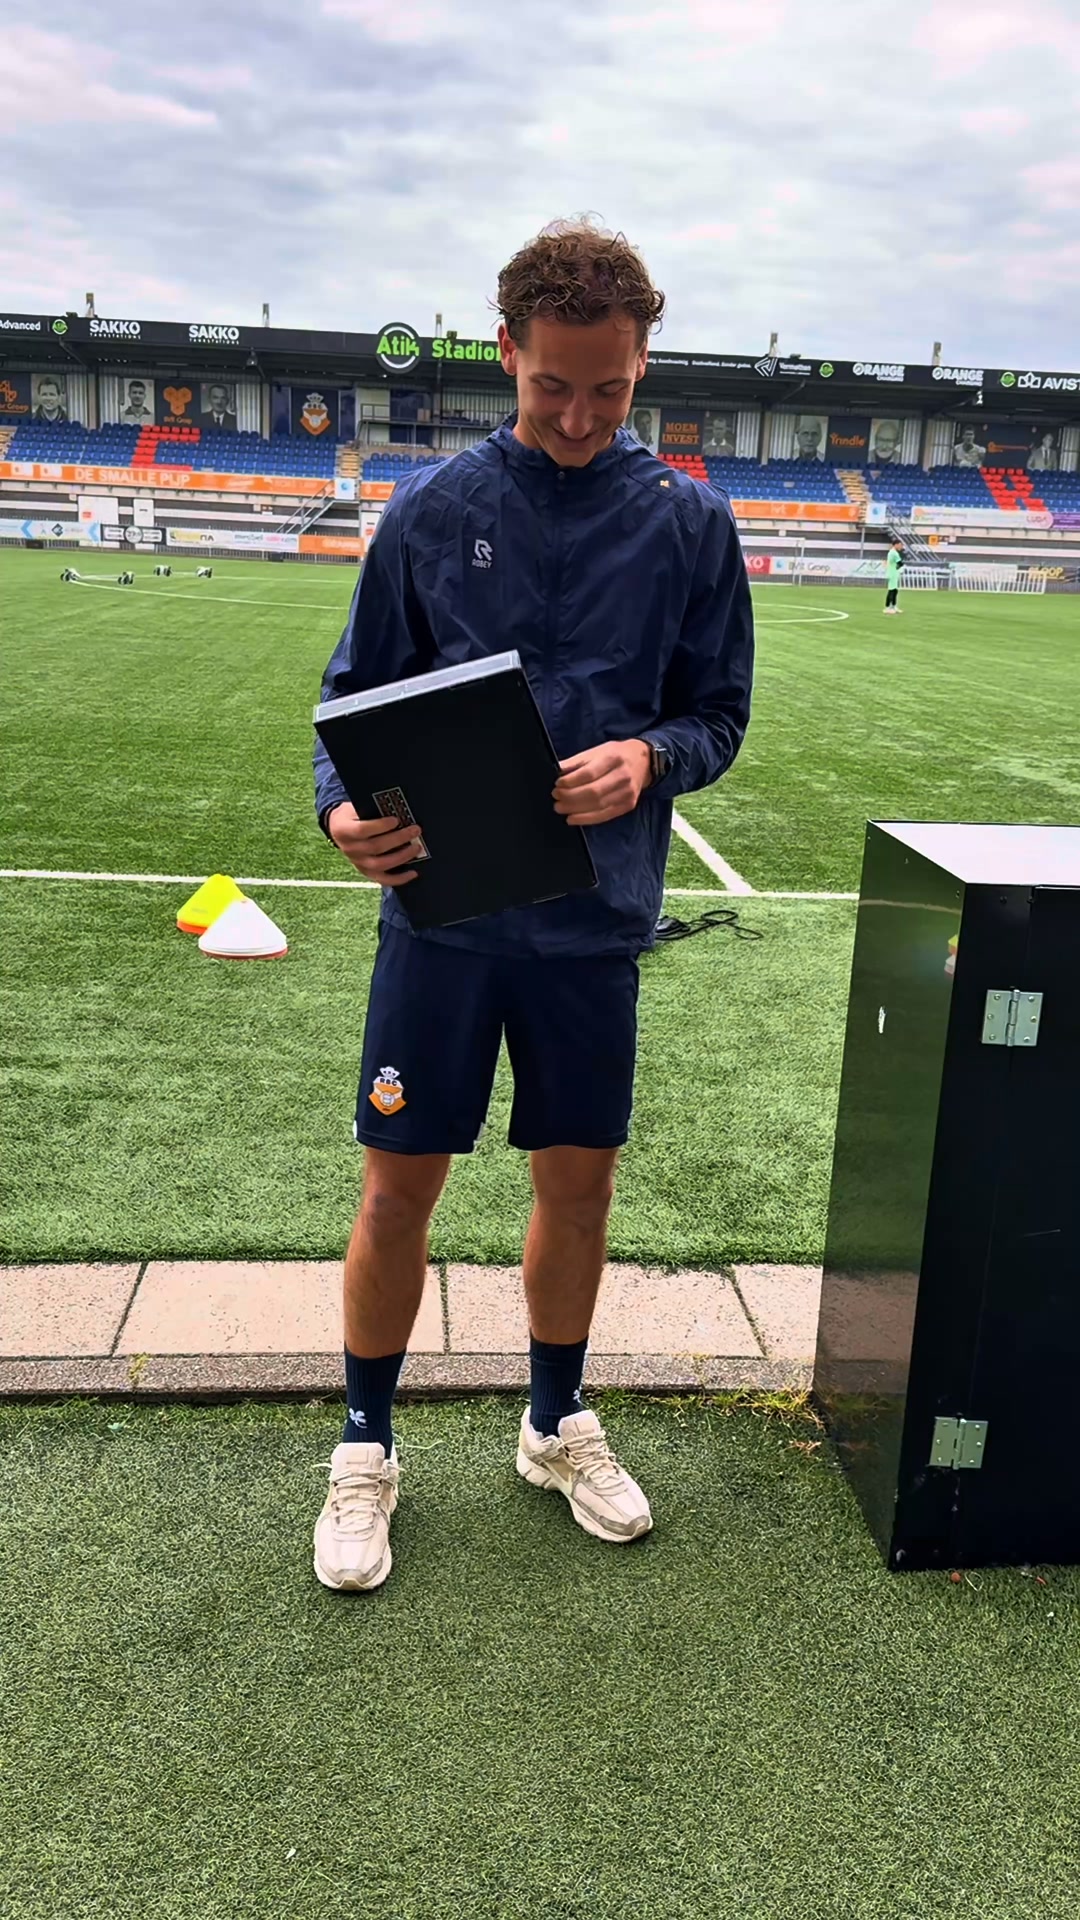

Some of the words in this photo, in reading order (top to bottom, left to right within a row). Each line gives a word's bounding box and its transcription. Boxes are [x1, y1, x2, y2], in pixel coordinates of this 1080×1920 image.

[0, 319, 41, 331] Advanced
[89, 319, 141, 335] SAKKO
[188, 325, 239, 340] SAKKO
[852, 362, 905, 377] ORANGE
[932, 367, 984, 381] ORANGE
[665, 422, 698, 433] MOEM
[662, 433, 699, 445] INVEST
[75, 468, 94, 481] DE
[98, 470, 157, 484] SMALLE
[379, 1077, 398, 1086] RBC
